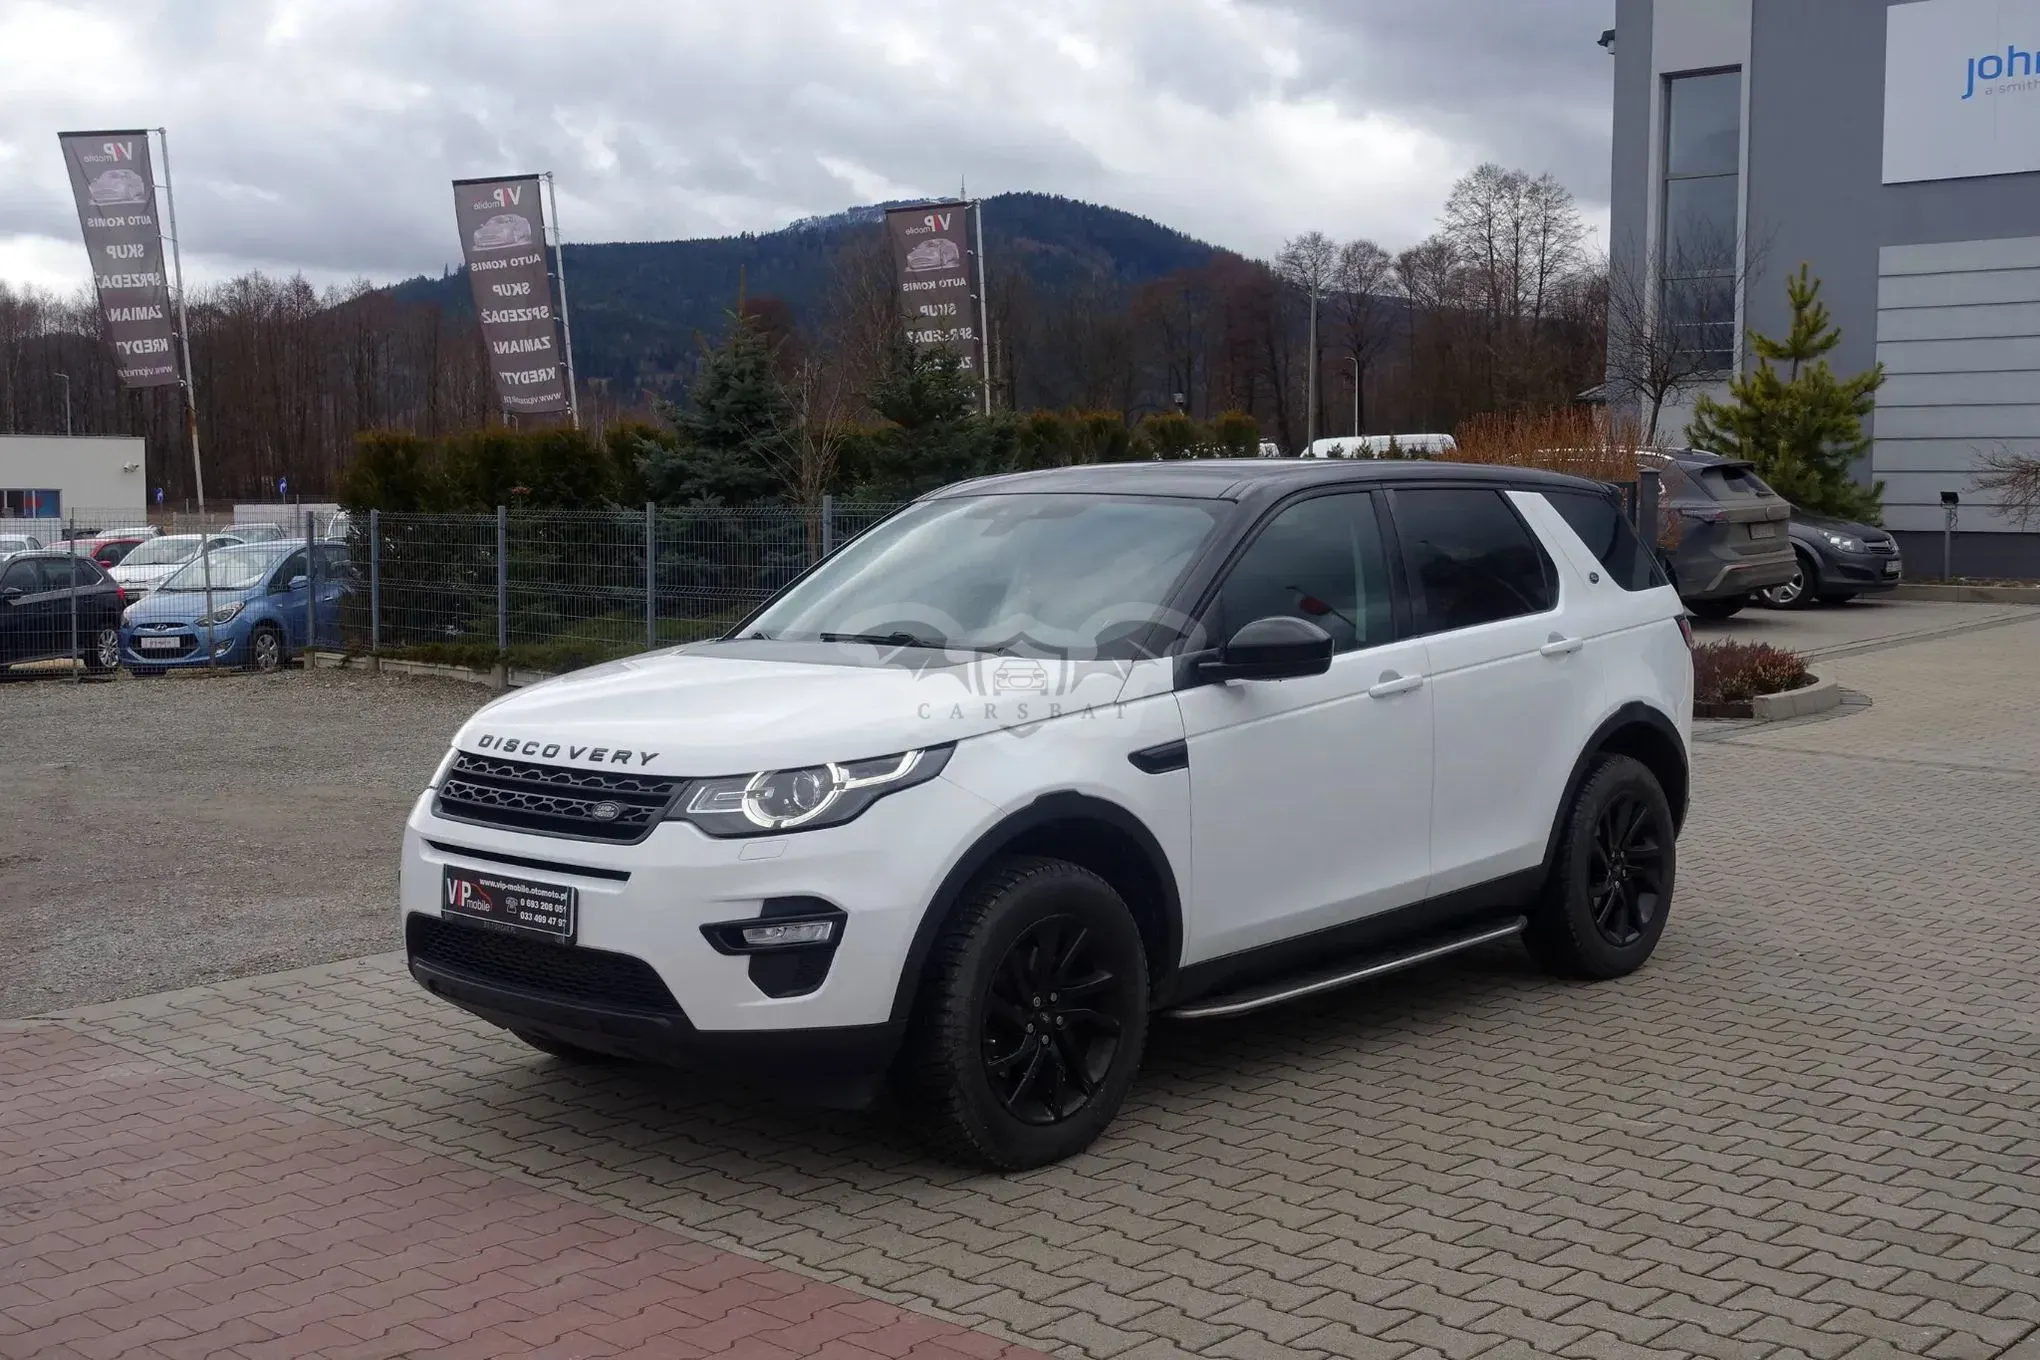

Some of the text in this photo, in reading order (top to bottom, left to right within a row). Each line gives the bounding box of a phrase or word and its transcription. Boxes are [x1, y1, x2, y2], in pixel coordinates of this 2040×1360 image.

[1961, 45, 2040, 99] joh
[478, 734, 660, 766] DISCOVERY
[447, 878, 471, 907] VIP
[466, 899, 491, 912] mobile
[526, 899, 539, 909] 693
[520, 912, 532, 921] 033
